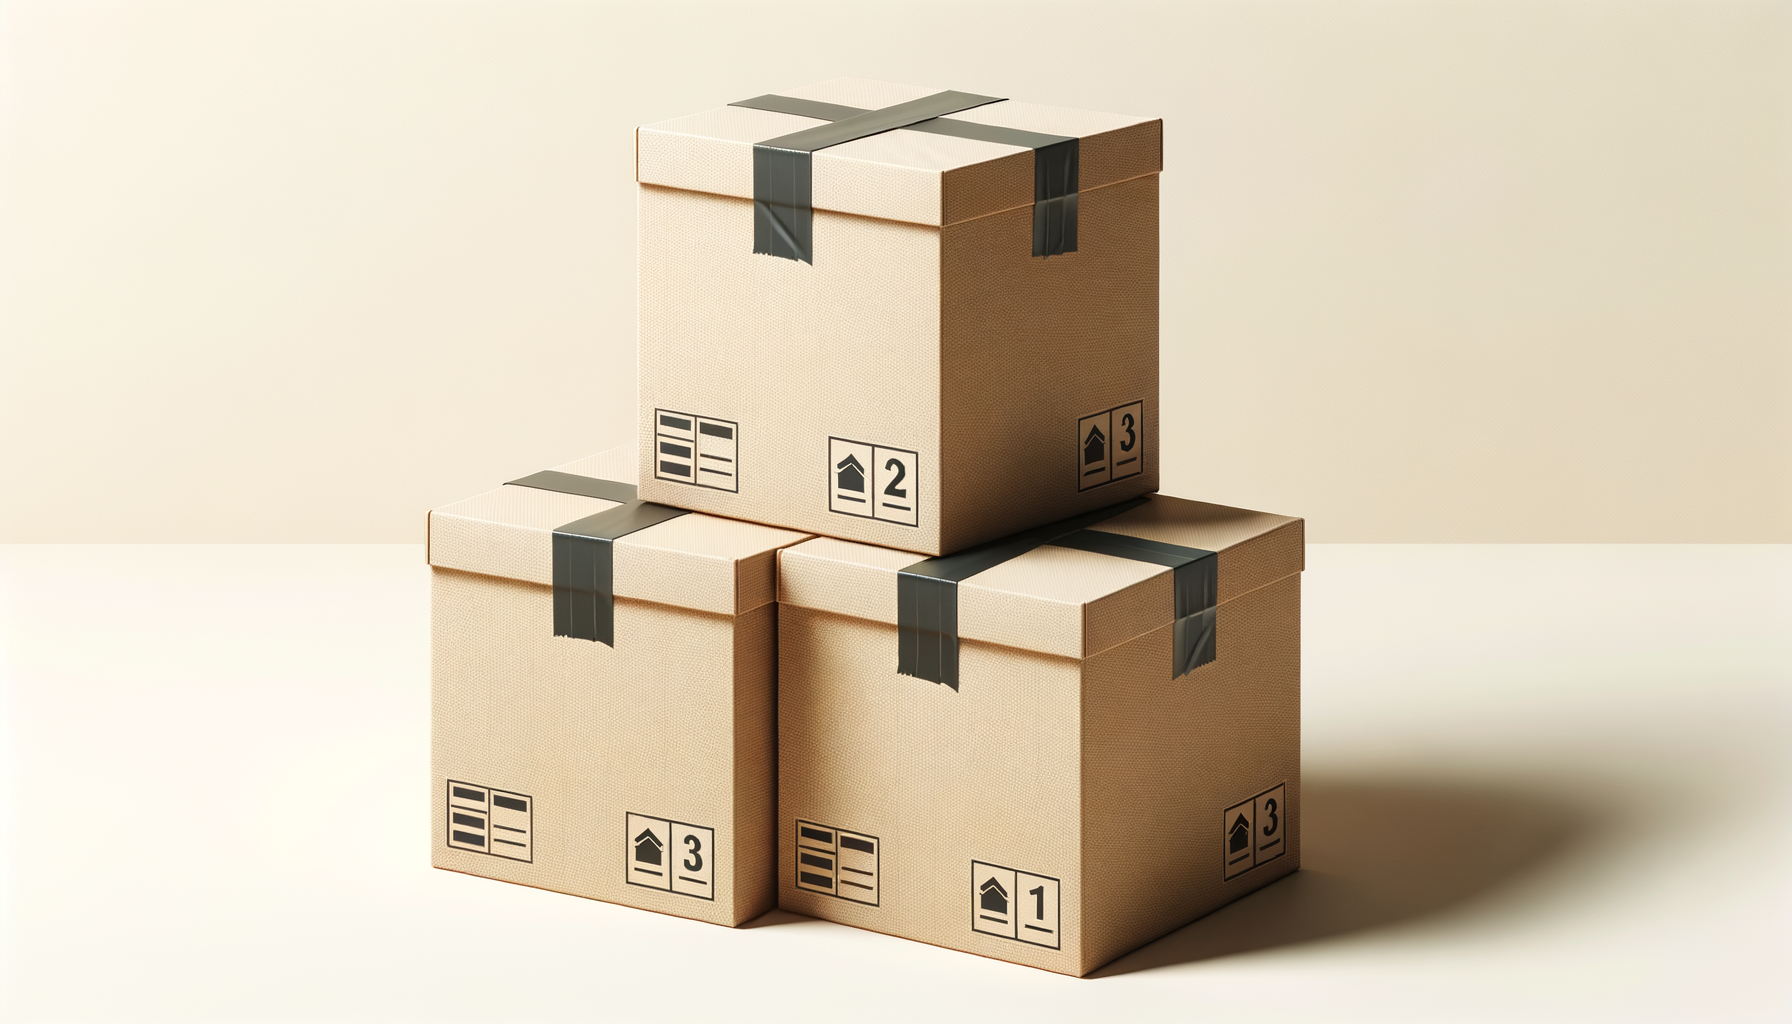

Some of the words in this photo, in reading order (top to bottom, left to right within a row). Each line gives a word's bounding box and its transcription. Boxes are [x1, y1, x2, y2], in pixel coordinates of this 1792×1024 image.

[1120, 412, 1136, 453] 3
[884, 458, 907, 499] 2
[1263, 797, 1278, 837] 3
[683, 834, 703, 872] 3
[1029, 885, 1044, 921] 1
